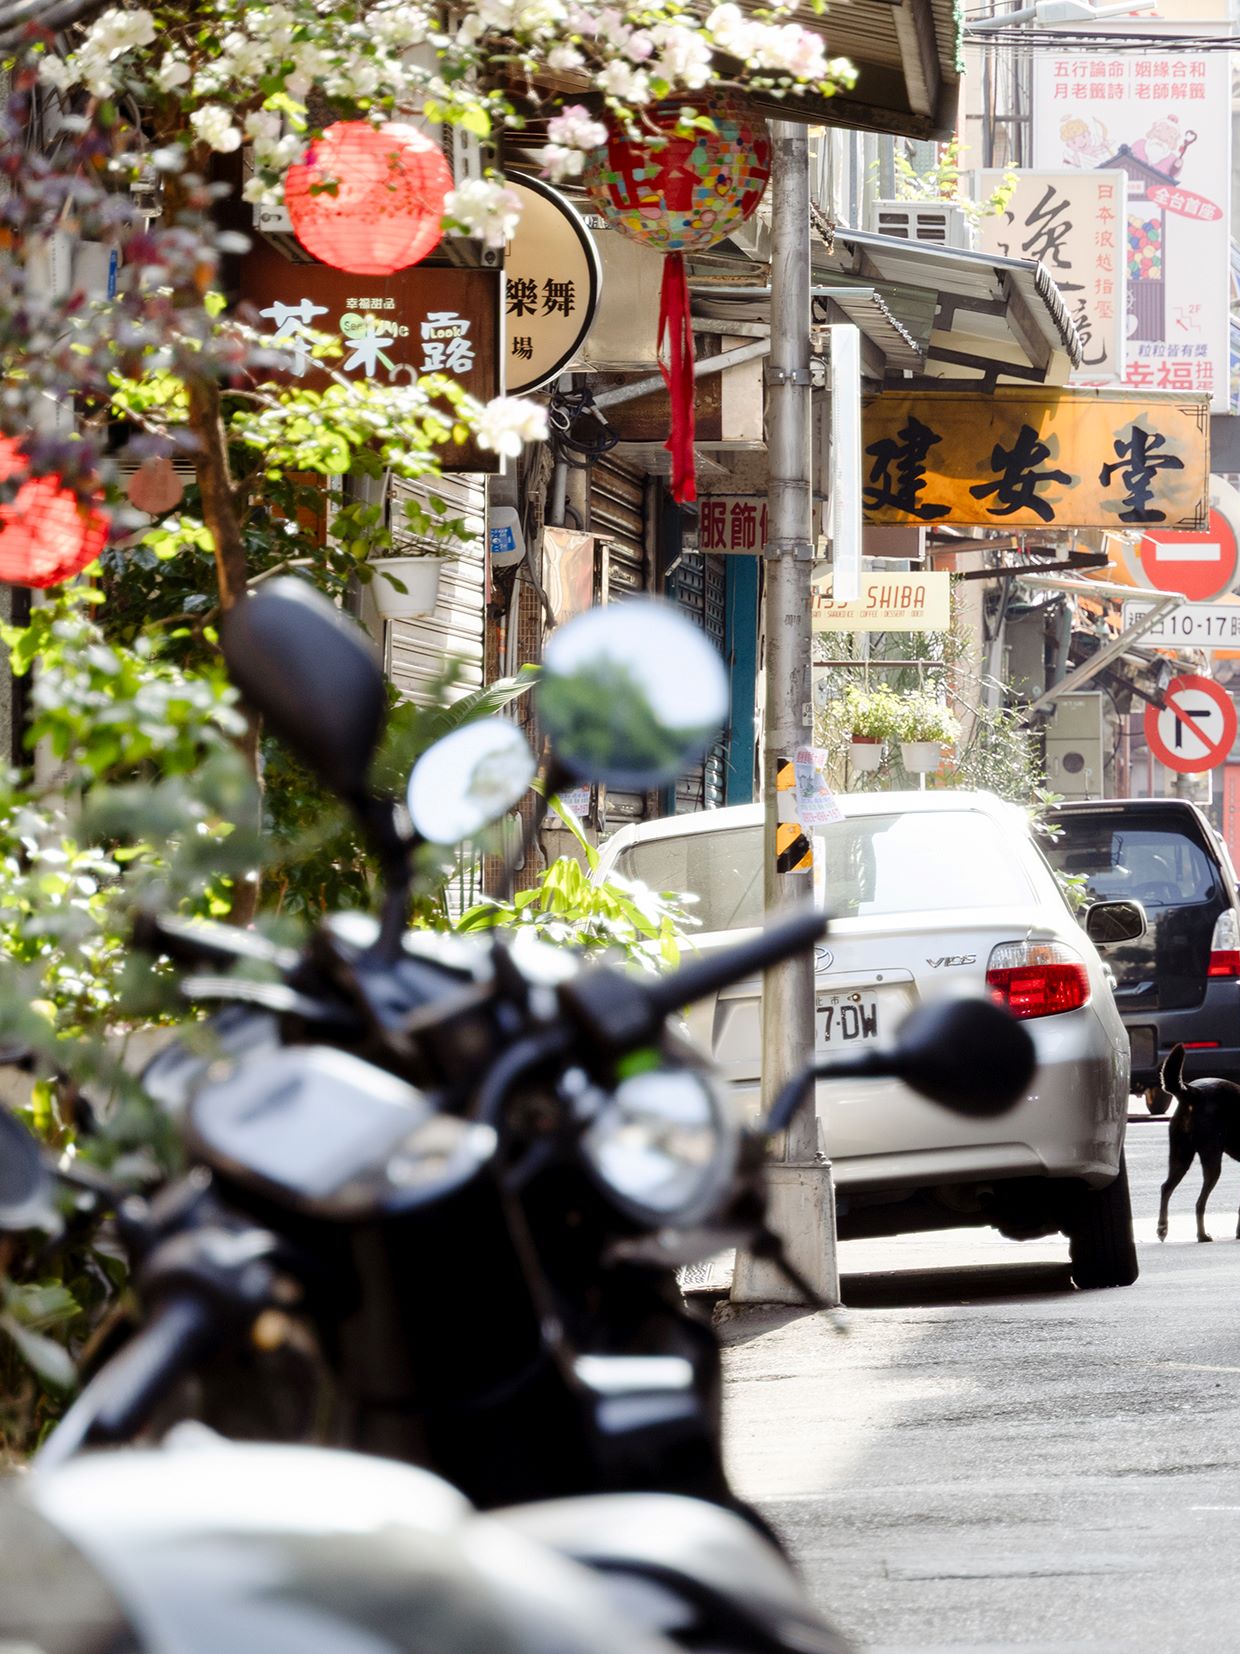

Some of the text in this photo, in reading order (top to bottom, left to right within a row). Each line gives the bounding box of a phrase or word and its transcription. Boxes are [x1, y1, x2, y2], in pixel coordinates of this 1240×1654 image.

[1054, 61, 1206, 78] 五行論命 姻緣合和
[1154, 187, 1217, 220] 全台首座
[1094, 184, 1116, 319] 日本浪越指壓
[506, 278, 576, 318] 樂舞
[511, 336, 534, 361] 場
[1121, 361, 1193, 390] 幸福
[863, 415, 1185, 523] 建安堂
[866, 585, 926, 609] SHIBA
